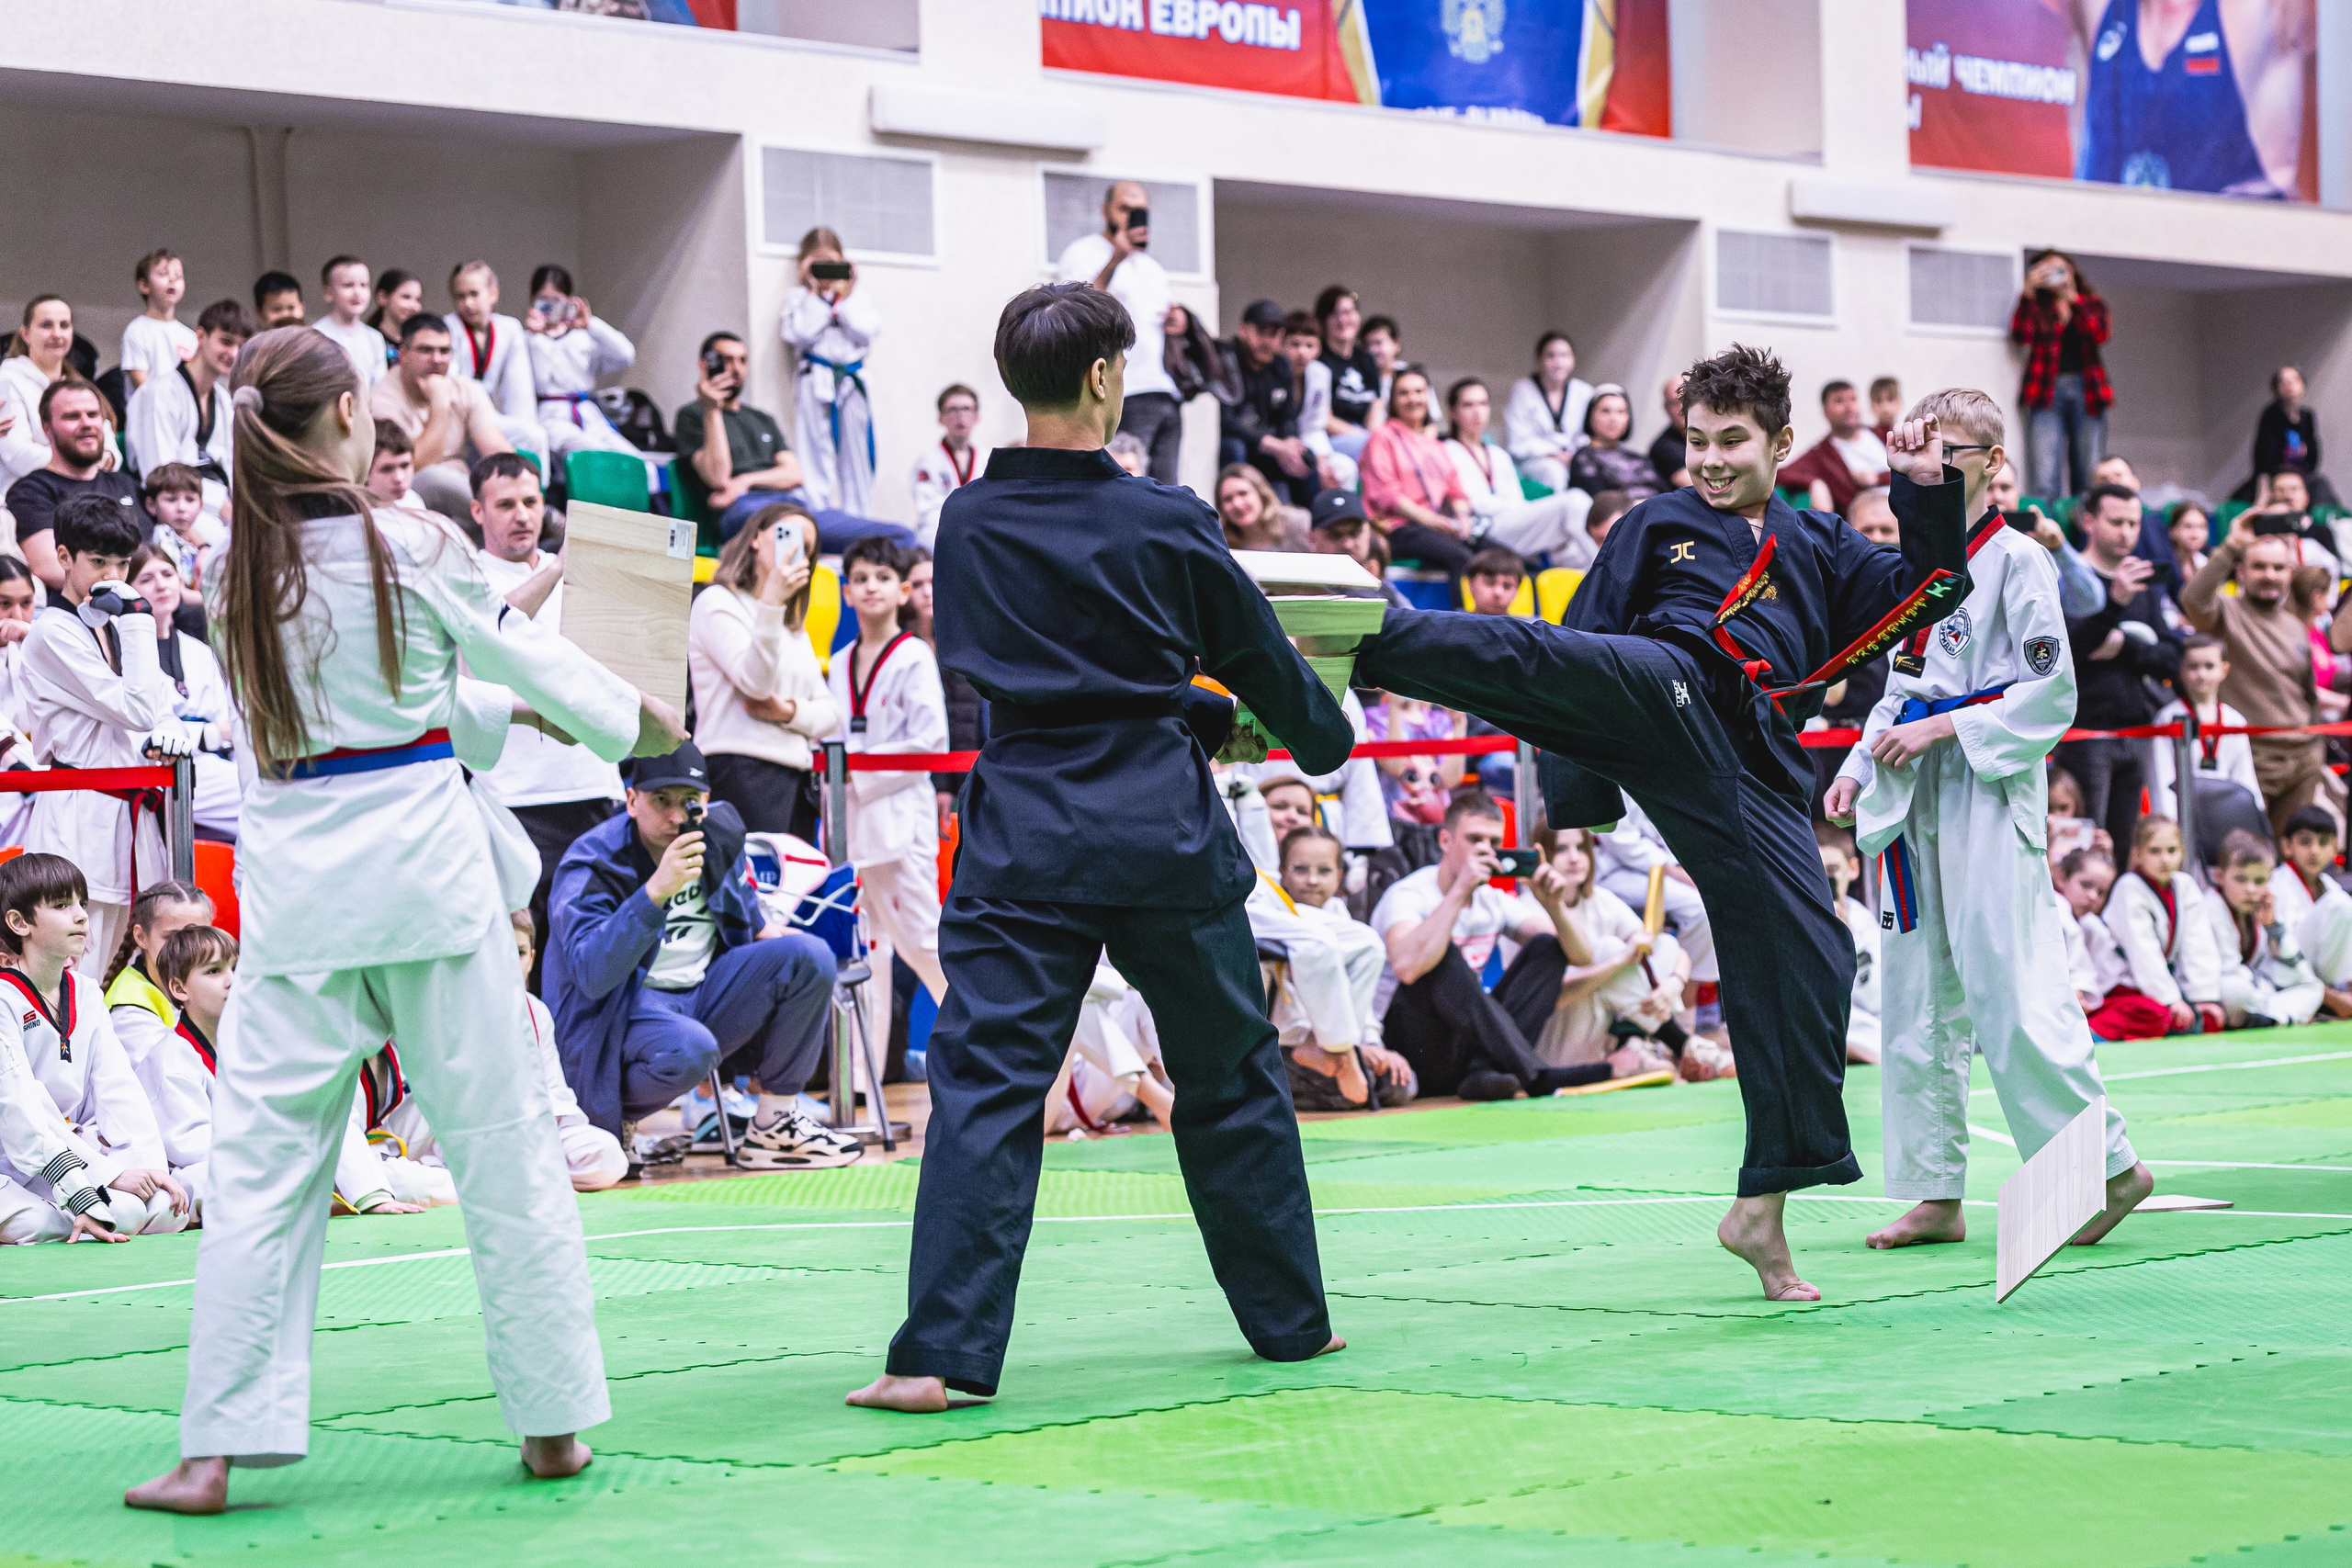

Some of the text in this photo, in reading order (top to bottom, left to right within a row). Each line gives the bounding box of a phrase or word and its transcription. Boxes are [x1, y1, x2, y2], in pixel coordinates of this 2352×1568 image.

[1039, 0, 1301, 51] ПИОН ЕВРОПЫ
[1952, 53, 2076, 107] ЧЕМПИОН
[23, 1019, 40, 1032] SHINO
